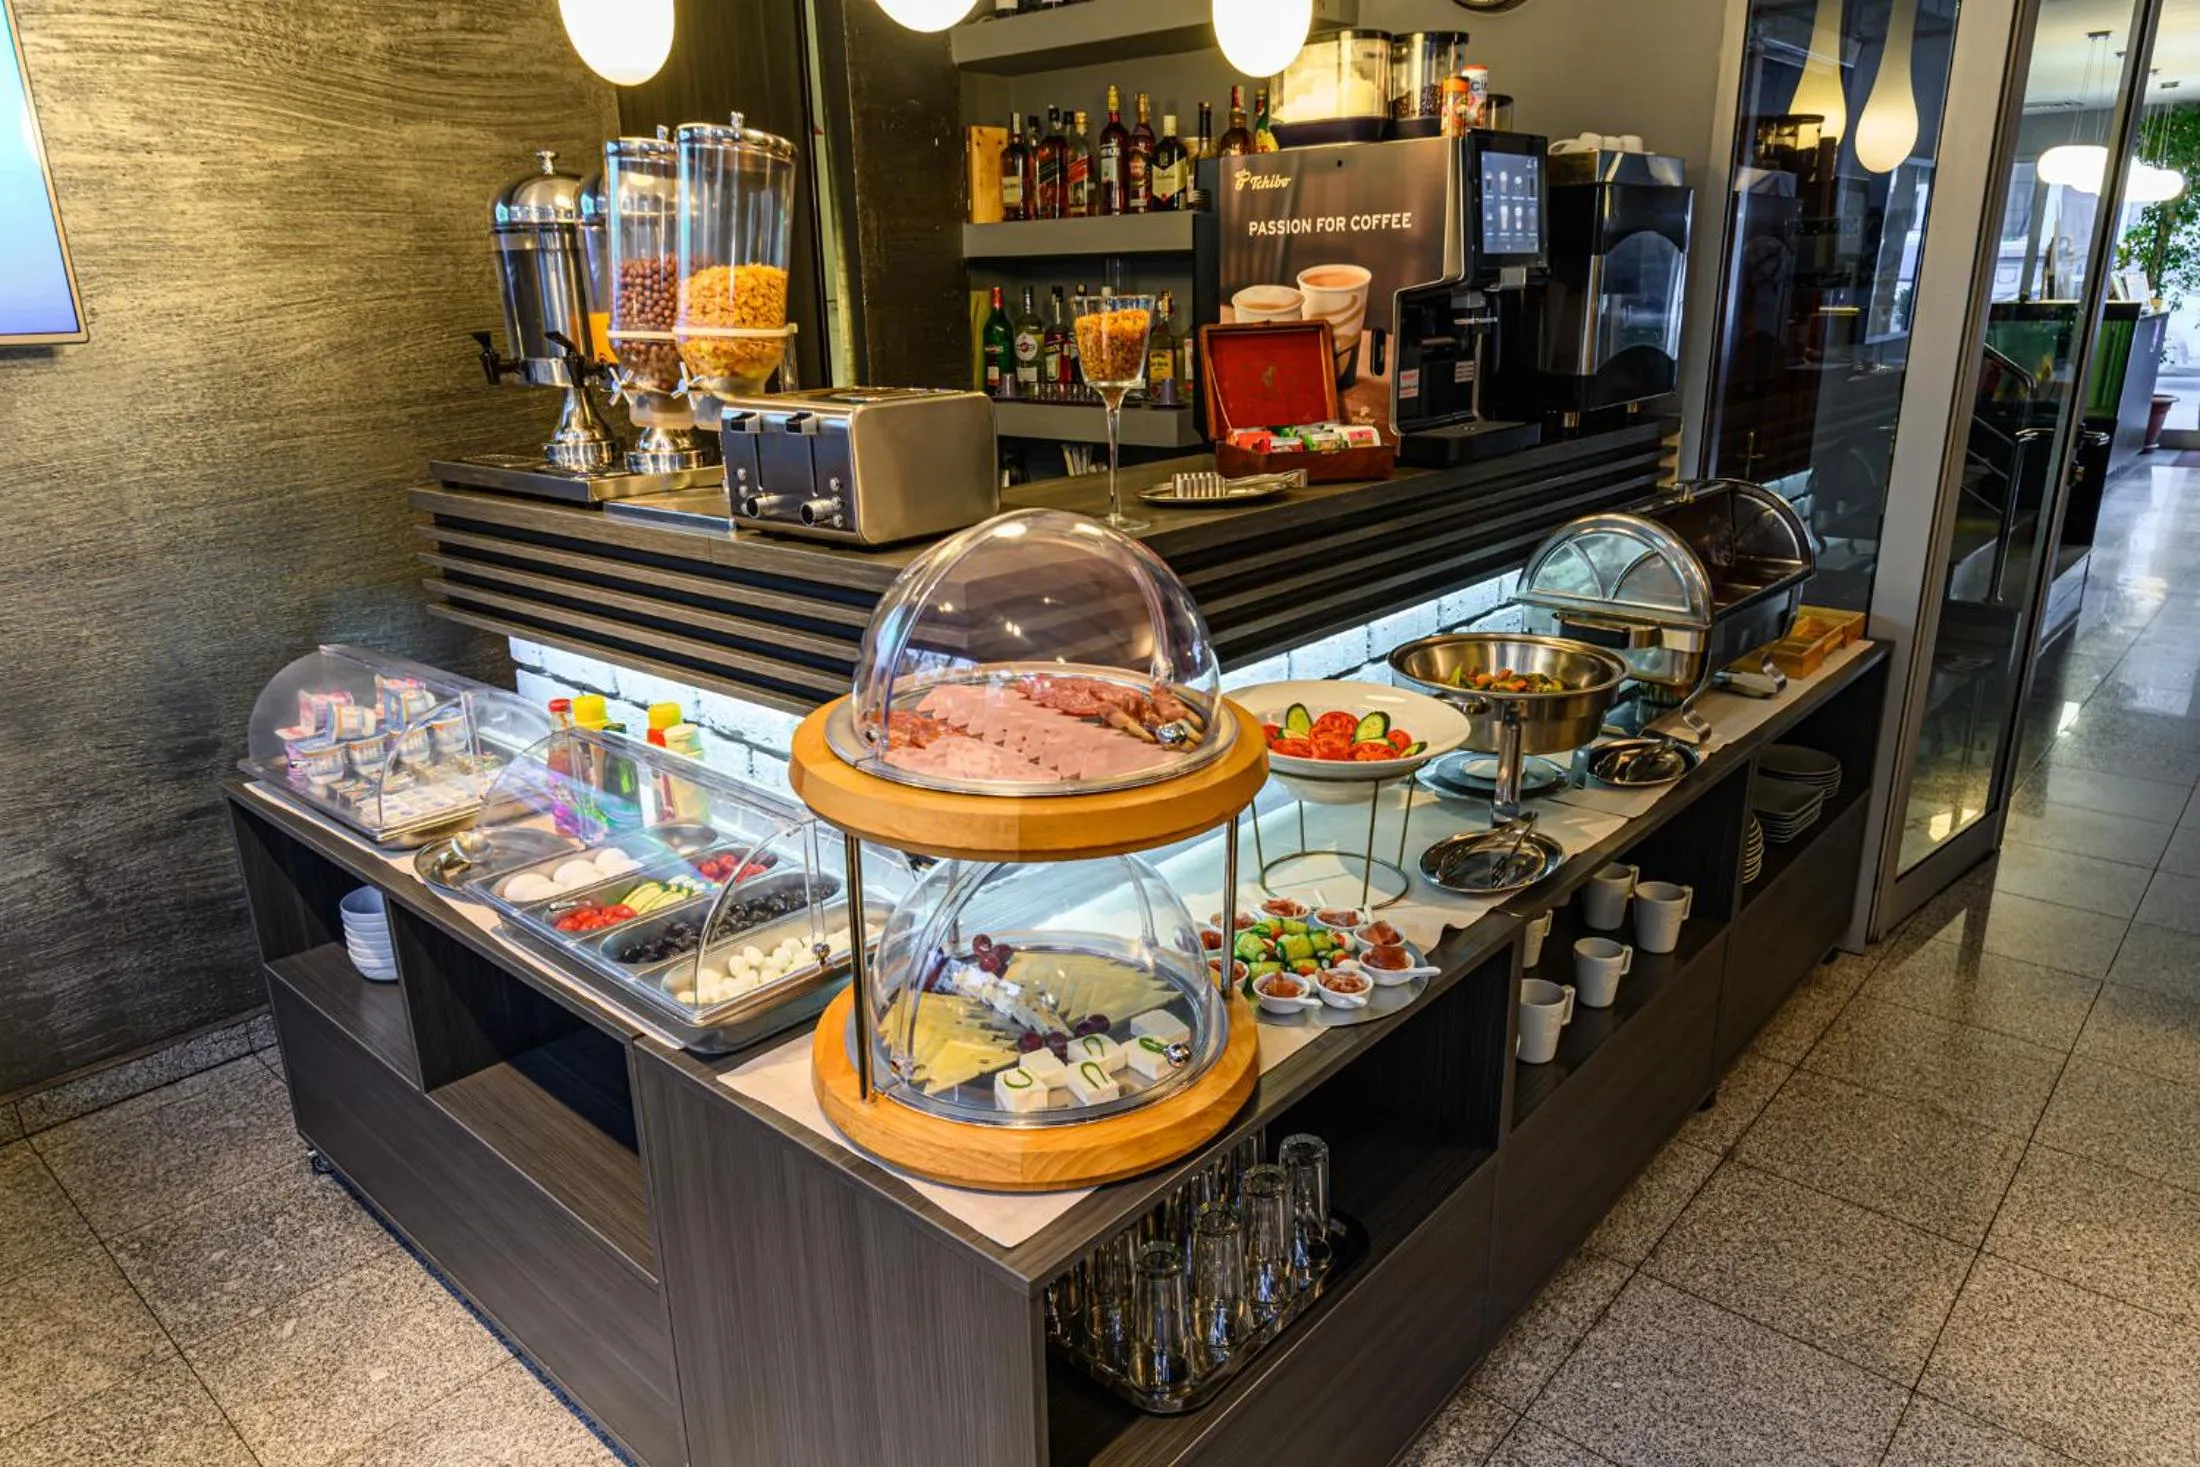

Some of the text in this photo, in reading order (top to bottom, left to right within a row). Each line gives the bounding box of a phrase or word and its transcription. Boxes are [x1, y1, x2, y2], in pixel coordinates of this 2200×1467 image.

[1250, 174, 1291, 190] Tchibo
[1249, 212, 1412, 236] PASSION FOR COFFEE
